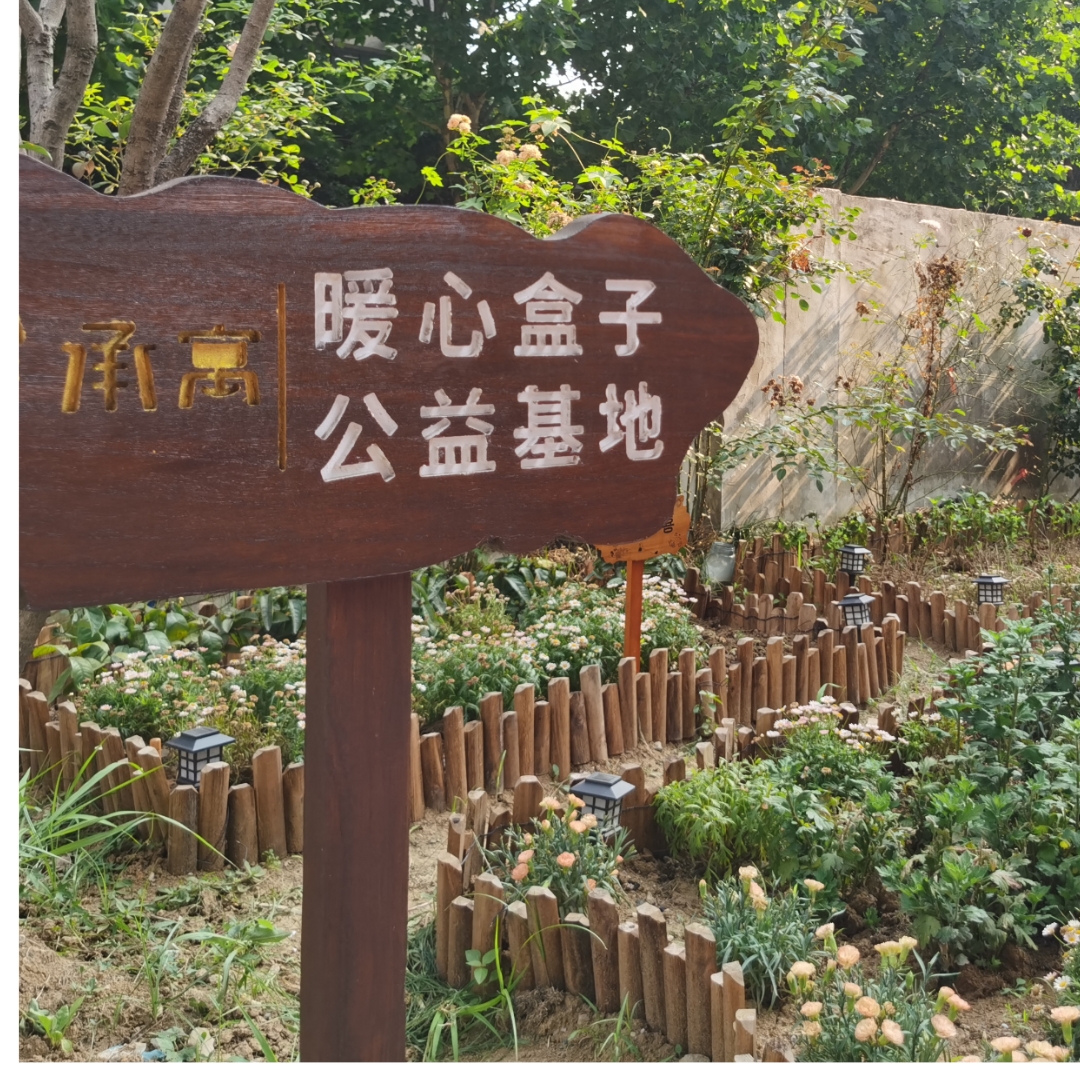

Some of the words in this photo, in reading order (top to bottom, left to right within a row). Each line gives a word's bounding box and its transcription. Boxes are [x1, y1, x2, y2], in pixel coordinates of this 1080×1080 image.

[314, 268, 663, 362] 暖心盒子
[60, 319, 262, 414] 承寓
[315, 382, 665, 483] 公益基地
